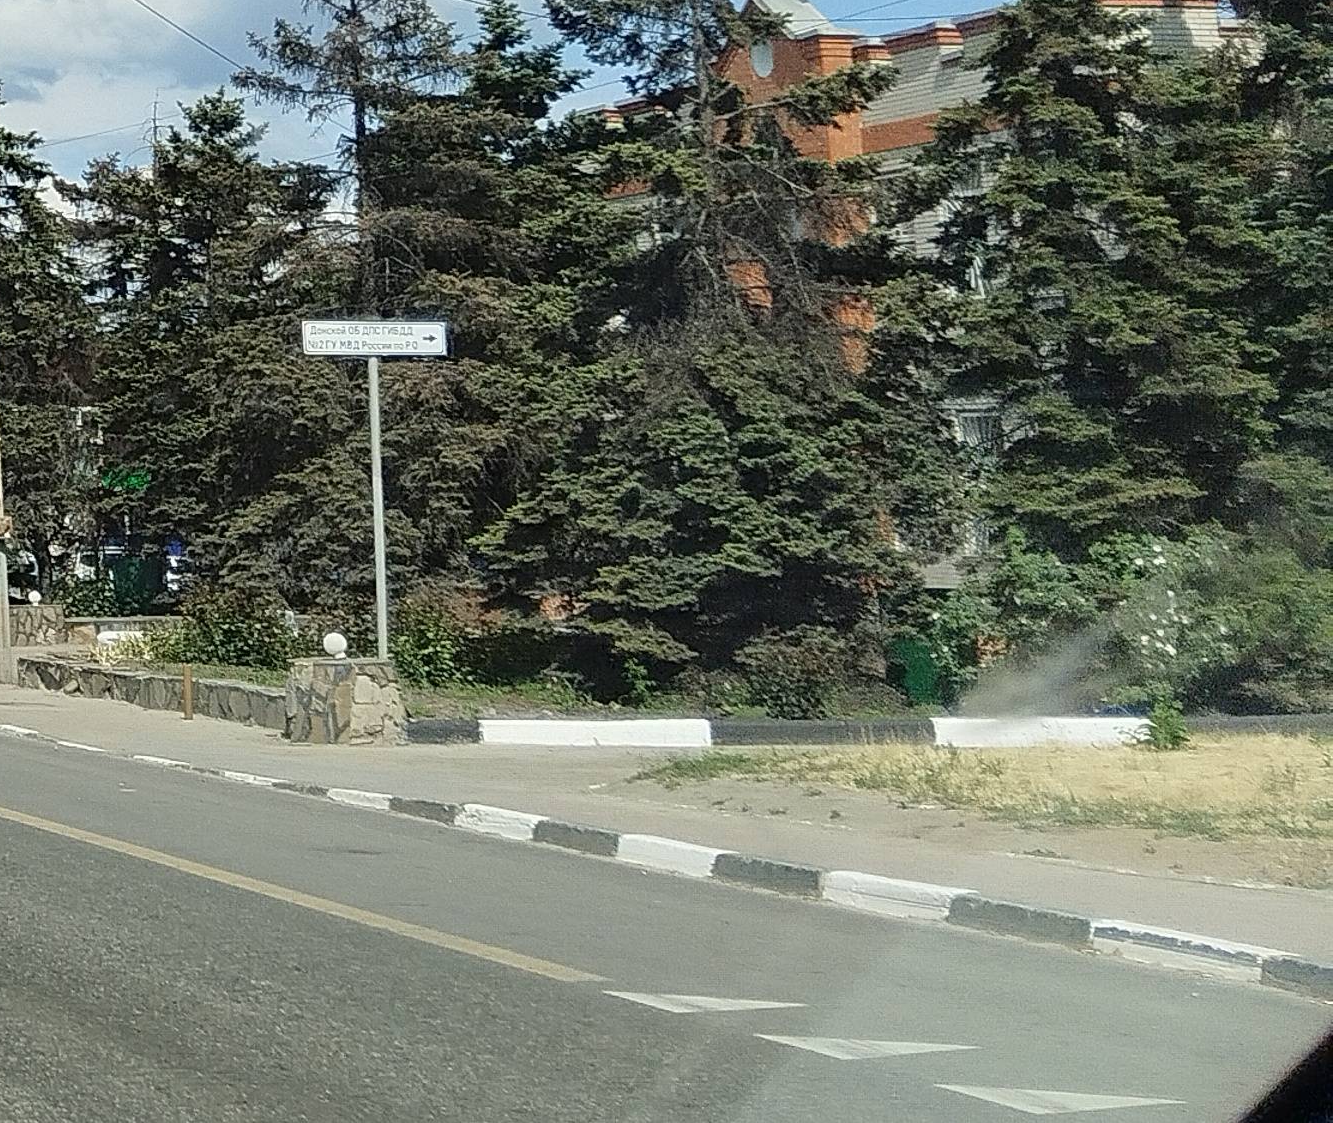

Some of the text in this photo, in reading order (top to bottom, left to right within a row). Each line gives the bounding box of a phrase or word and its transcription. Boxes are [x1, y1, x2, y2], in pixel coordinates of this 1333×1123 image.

[310, 325, 414, 336] Донской ОБ ДПС ГИБДД
[325, 340, 337, 350] ГУ
[340, 340, 360, 350] МВД
[362, 340, 392, 350] России
